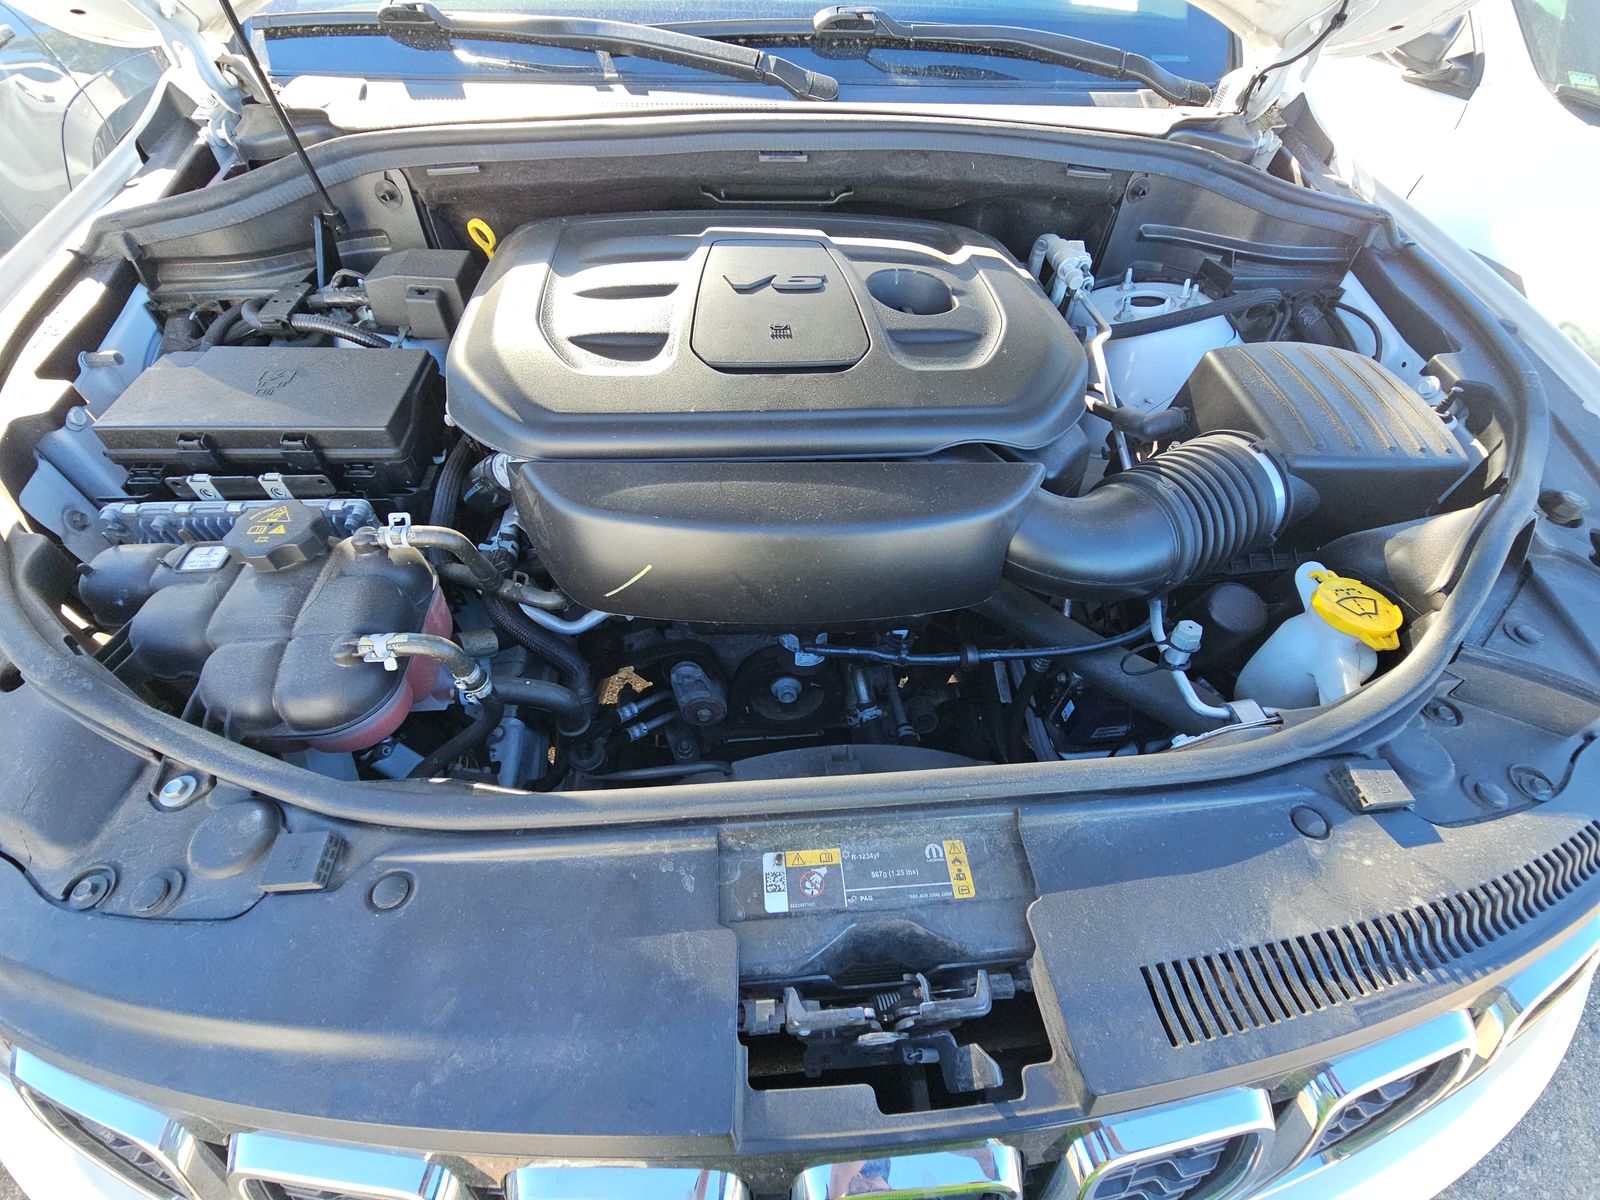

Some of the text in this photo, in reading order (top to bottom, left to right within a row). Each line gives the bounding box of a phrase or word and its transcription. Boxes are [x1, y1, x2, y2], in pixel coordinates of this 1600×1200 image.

[722, 274, 828, 294] V6
[851, 852, 880, 861] R-1234yf
[889, 868, 904, 878] (1.25
[906, 867, 919, 876] lbs)
